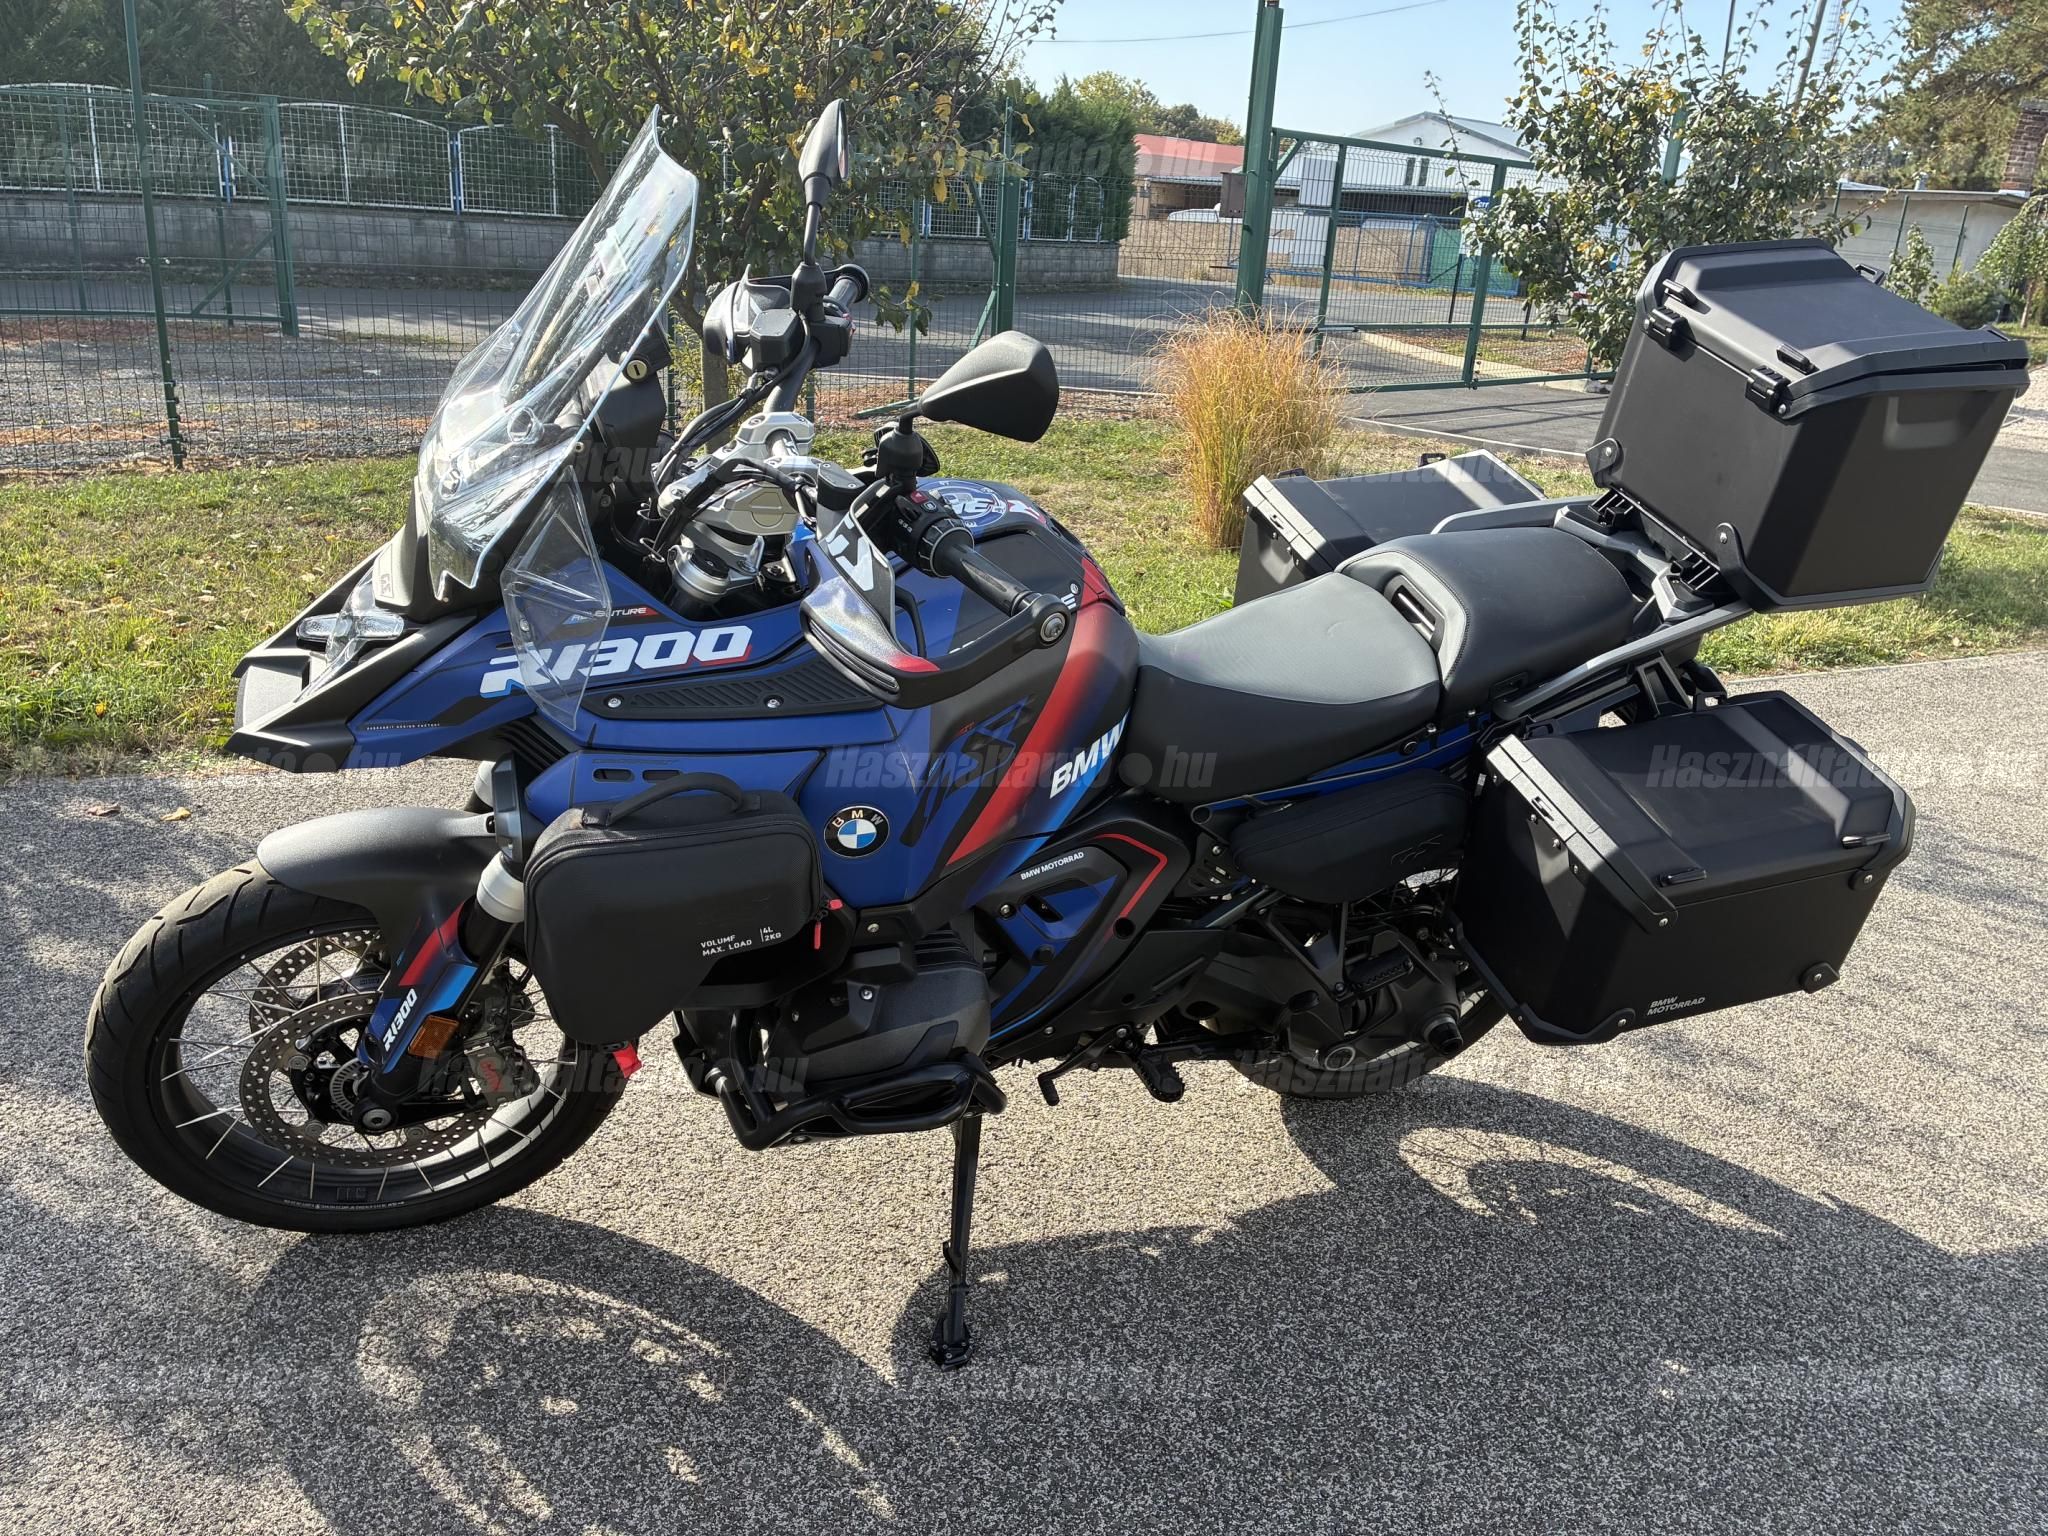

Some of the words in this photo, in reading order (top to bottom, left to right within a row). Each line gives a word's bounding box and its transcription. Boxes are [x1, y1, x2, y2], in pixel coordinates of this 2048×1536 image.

[1049, 708, 1130, 799] BMW
[831, 809, 884, 828] BMW
[1020, 867, 1041, 880] BMW
[1041, 851, 1085, 873] MOTORRAD
[702, 945, 726, 957] MAX.
[728, 939, 753, 951] LOAD
[764, 932, 782, 942] 2KG
[1647, 997, 1706, 1016] MOTORRAD
[1650, 996, 1679, 1009] BMW
[382, 988, 418, 1052] R1300
